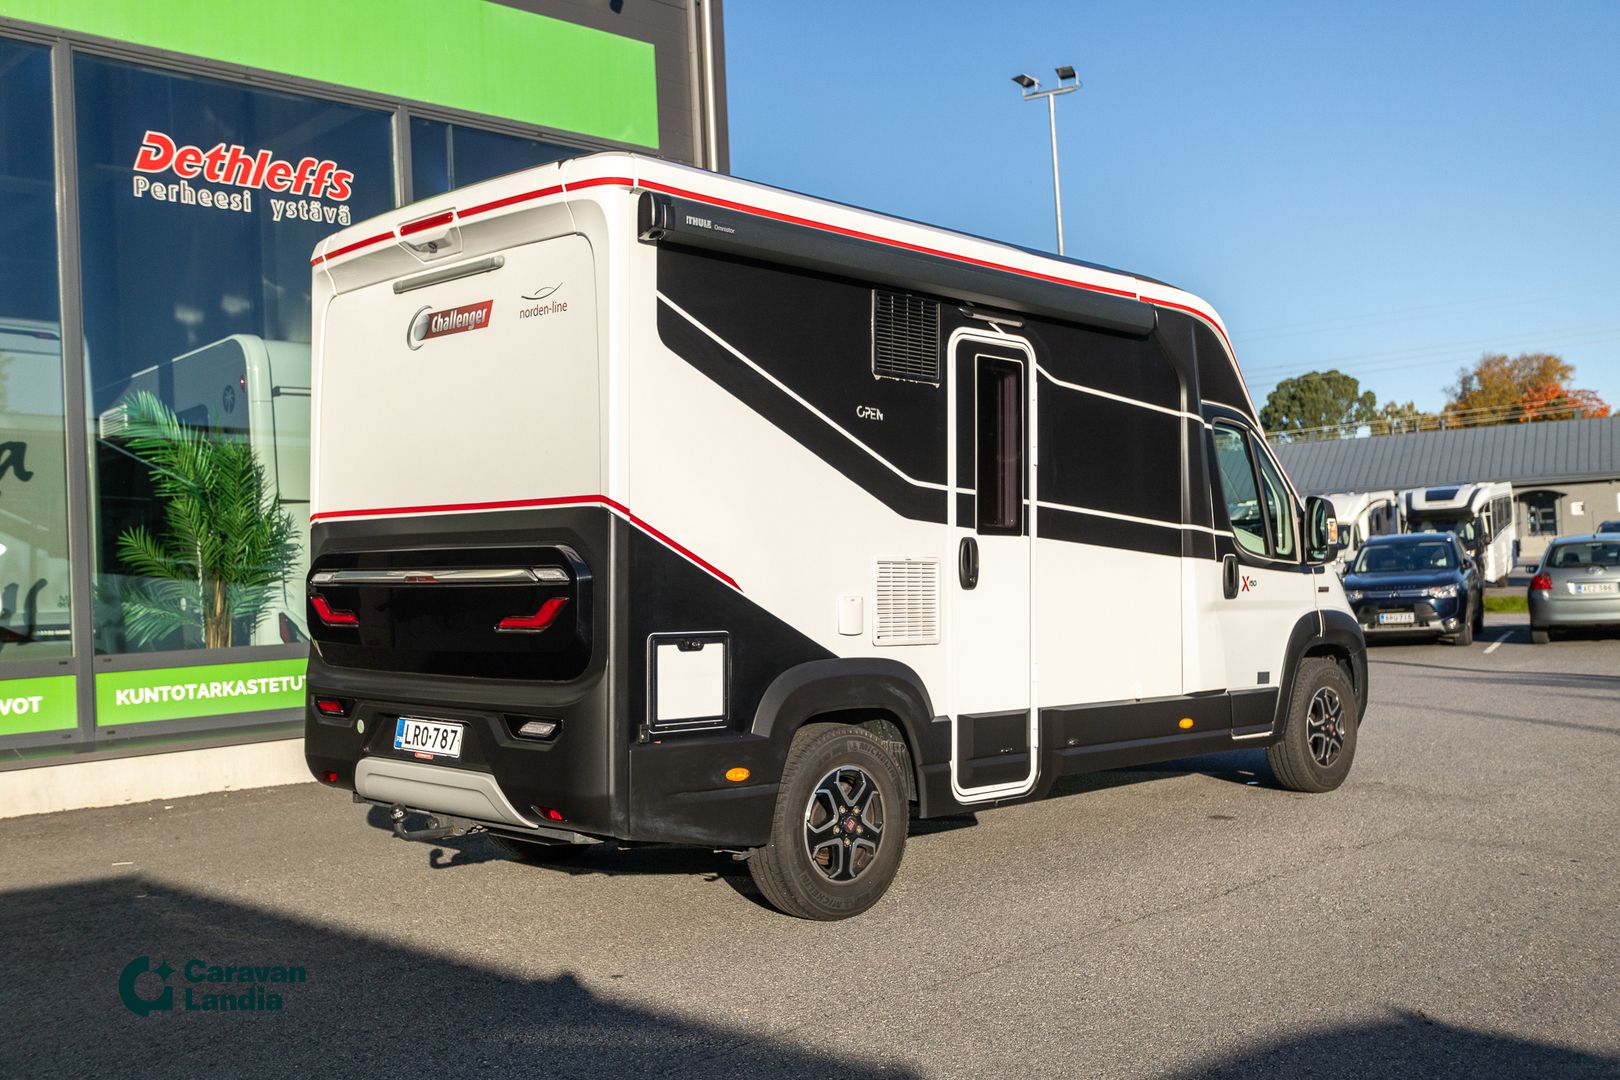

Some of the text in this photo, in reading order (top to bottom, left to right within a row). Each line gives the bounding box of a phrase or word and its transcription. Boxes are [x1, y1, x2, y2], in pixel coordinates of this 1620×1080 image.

[133, 130, 354, 201] Dethleffs
[133, 176, 351, 226] Perheesi ystävä
[685, 215, 712, 229] THULE
[431, 307, 488, 333] Challenger
[519, 301, 568, 319] norden-line
[856, 405, 884, 421] OPEN
[115, 674, 307, 706] KUNTOTARKASTETU
[403, 723, 459, 751] LRO-787
